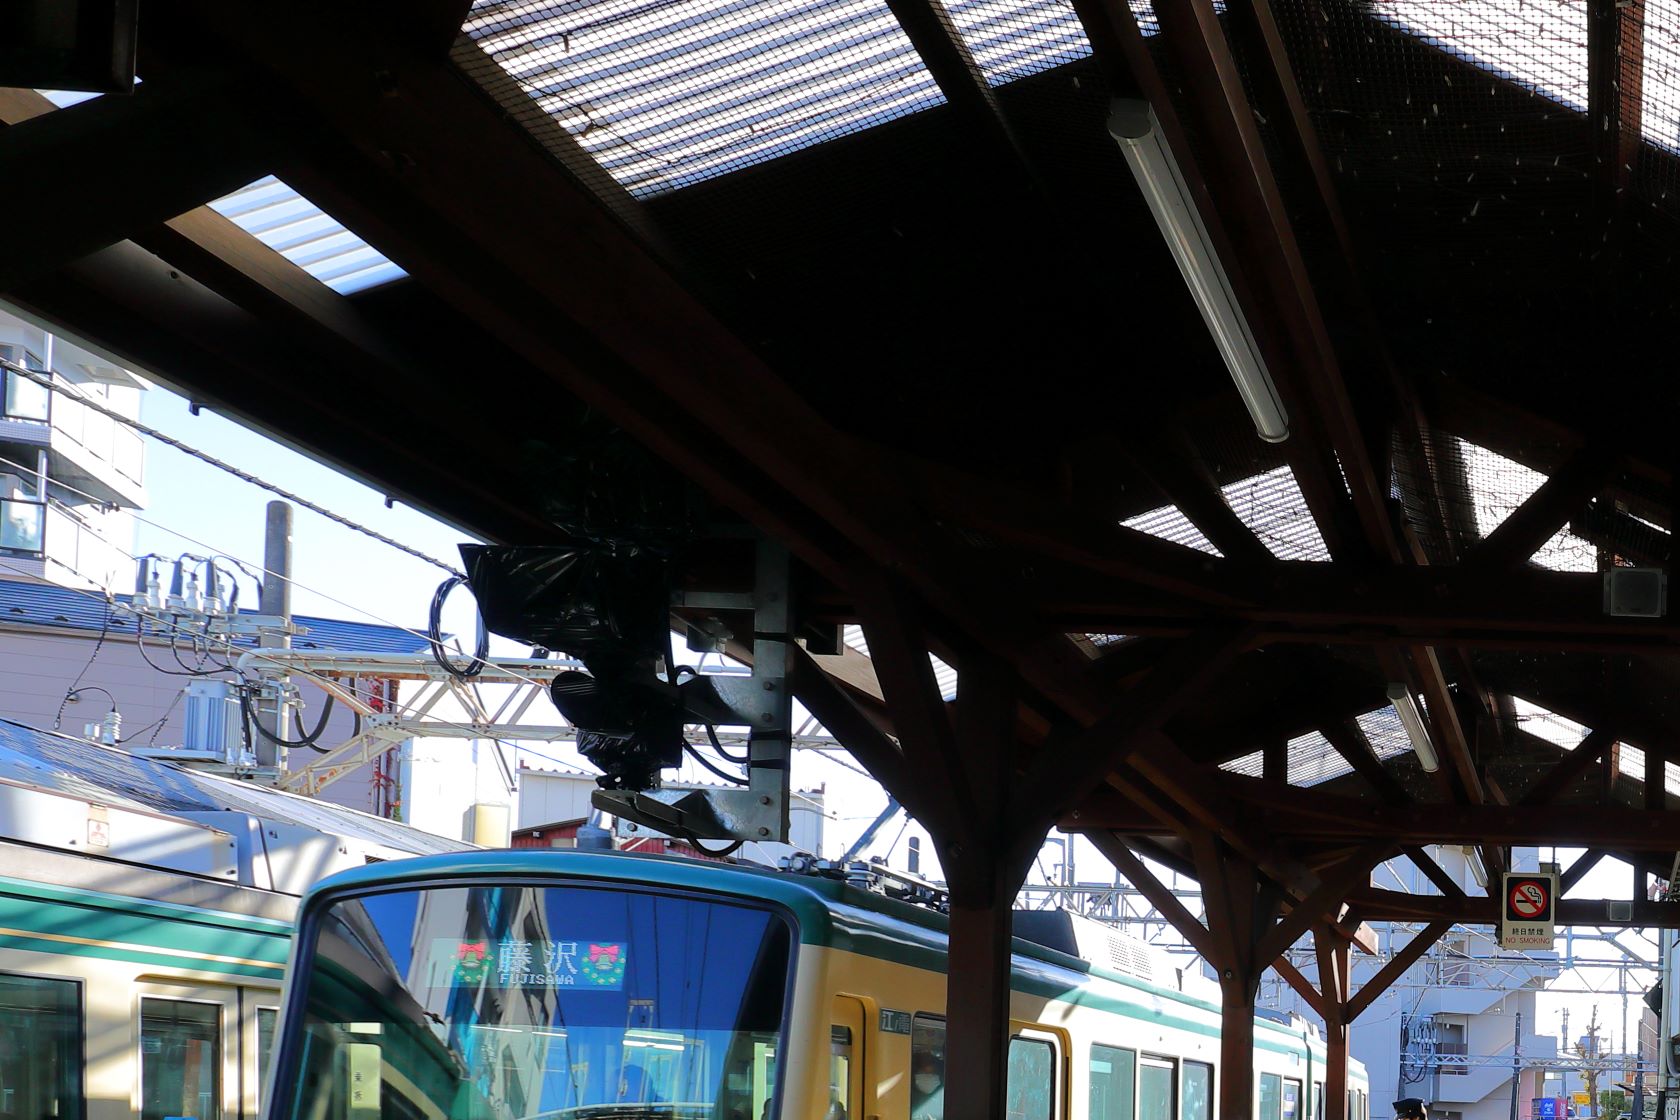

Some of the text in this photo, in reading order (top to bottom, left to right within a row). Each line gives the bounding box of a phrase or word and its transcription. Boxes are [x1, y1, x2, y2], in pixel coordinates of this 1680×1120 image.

[1512, 928, 1544, 936] 終日禁煙
[497, 941, 578, 975] 藤沢
[499, 973, 574, 985] FUJISAWA
[1666, 1107, 1676, 1116] 10
